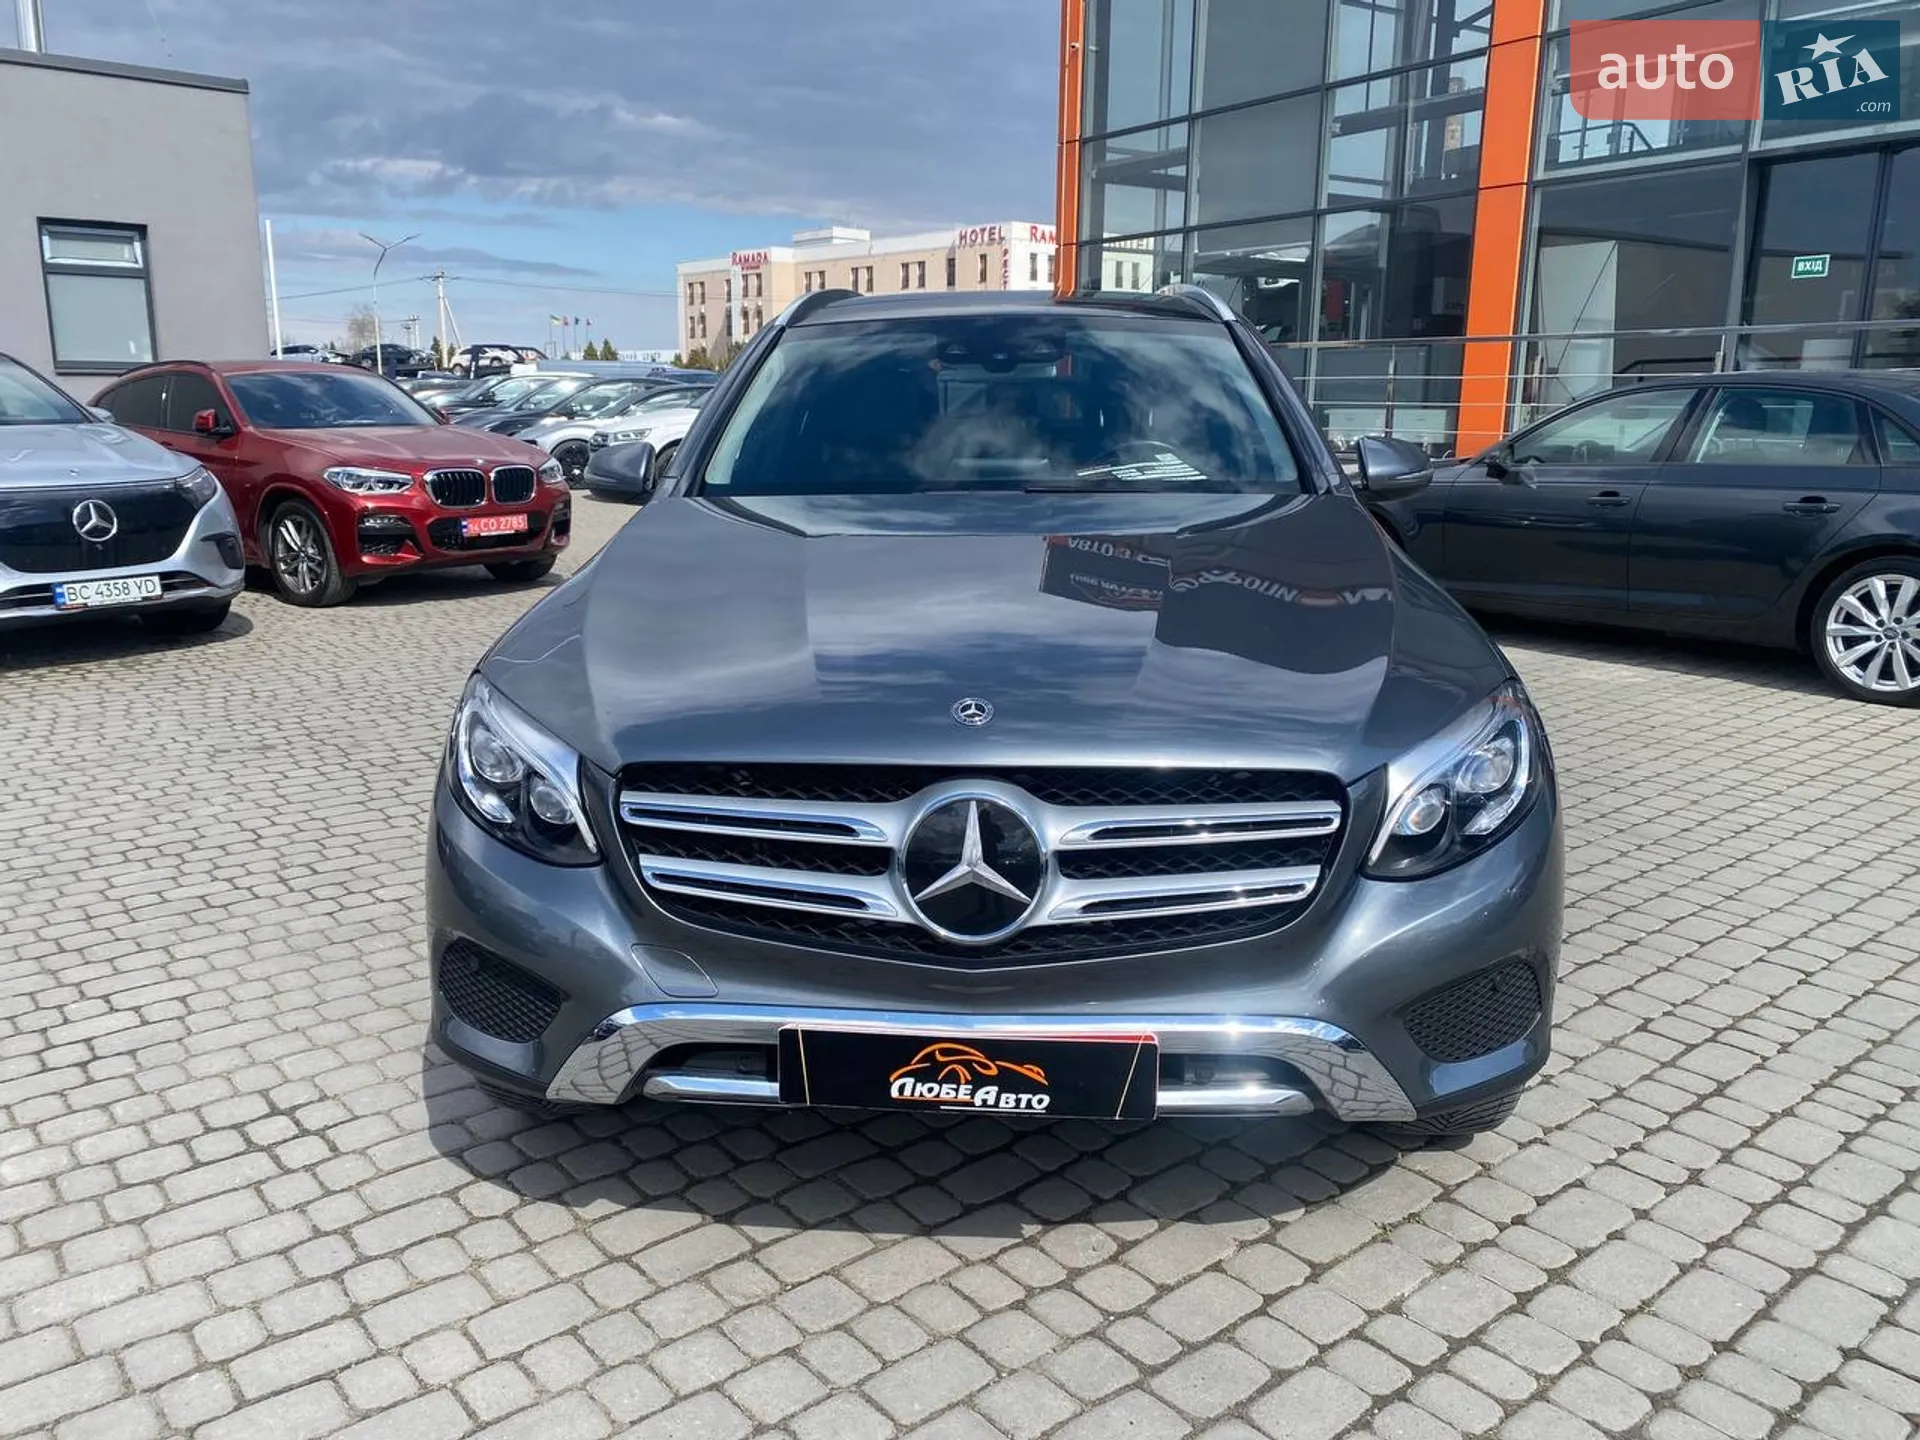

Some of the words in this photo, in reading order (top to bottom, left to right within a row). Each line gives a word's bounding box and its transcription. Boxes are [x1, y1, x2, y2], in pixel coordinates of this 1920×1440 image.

[959, 224, 1005, 246] HOTEL
[1030, 225, 1057, 245] RAM
[66, 585, 90, 601] BC
[95, 582, 130, 599] 4358
[134, 579, 156, 594] YD
